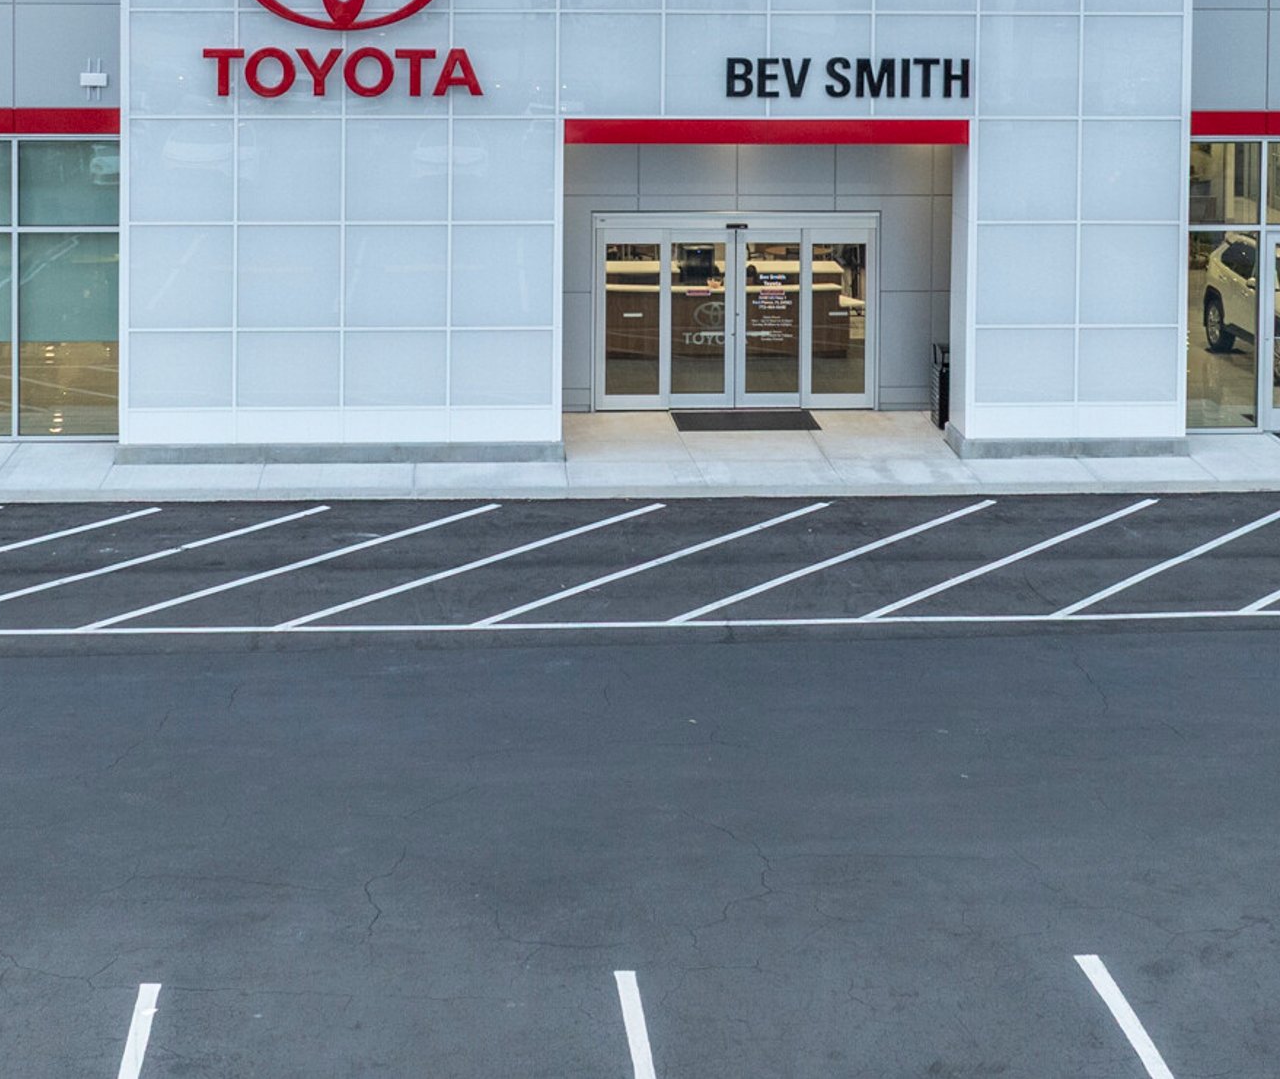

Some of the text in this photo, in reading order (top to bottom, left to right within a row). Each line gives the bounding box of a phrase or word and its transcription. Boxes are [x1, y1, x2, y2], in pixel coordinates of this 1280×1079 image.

[202, 47, 485, 98] TOYOTA
[725, 56, 971, 99] BEV SMITH
[682, 332, 748, 345] TOYO
